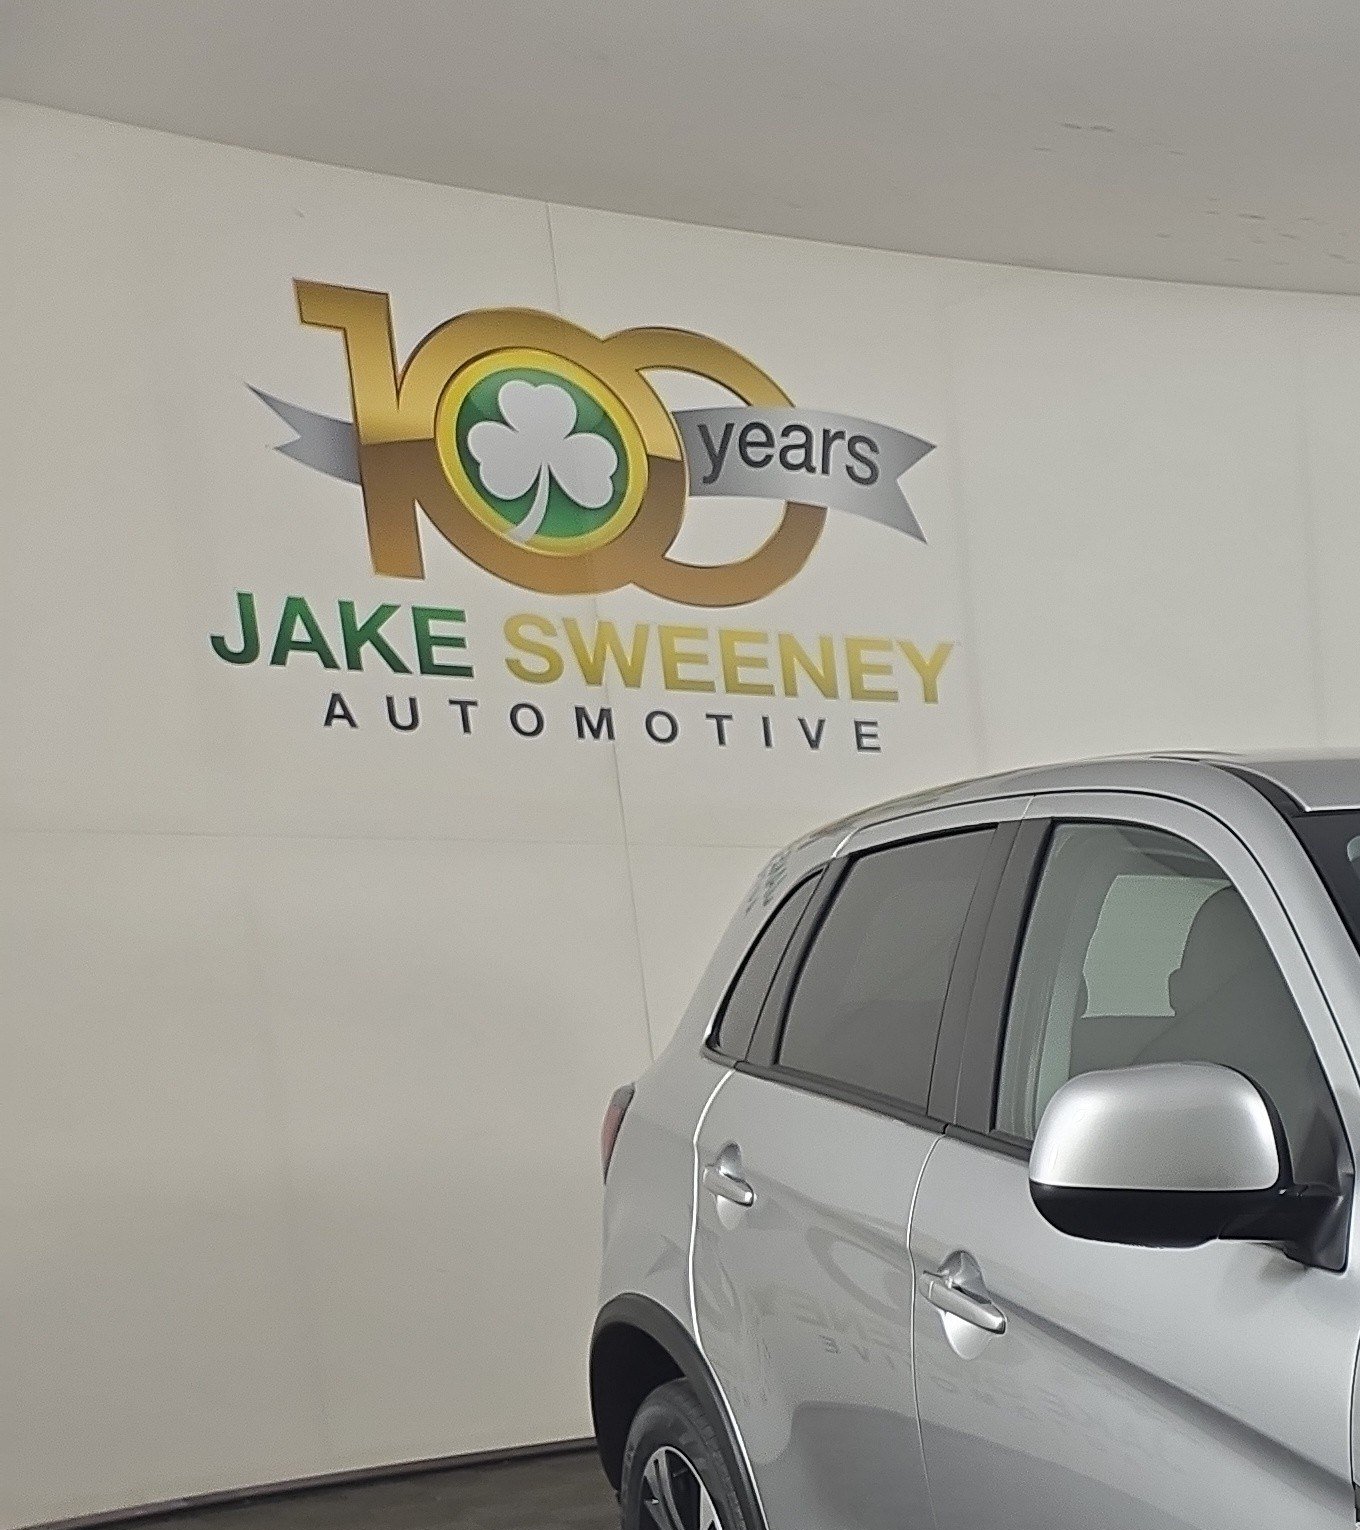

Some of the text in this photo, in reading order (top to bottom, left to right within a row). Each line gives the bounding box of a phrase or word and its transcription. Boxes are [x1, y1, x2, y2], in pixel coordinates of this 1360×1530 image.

[292, 279, 881, 609] 100 years
[210, 590, 952, 704] JAKE SWEENEY
[323, 692, 881, 752] AUTOMOTIVE
